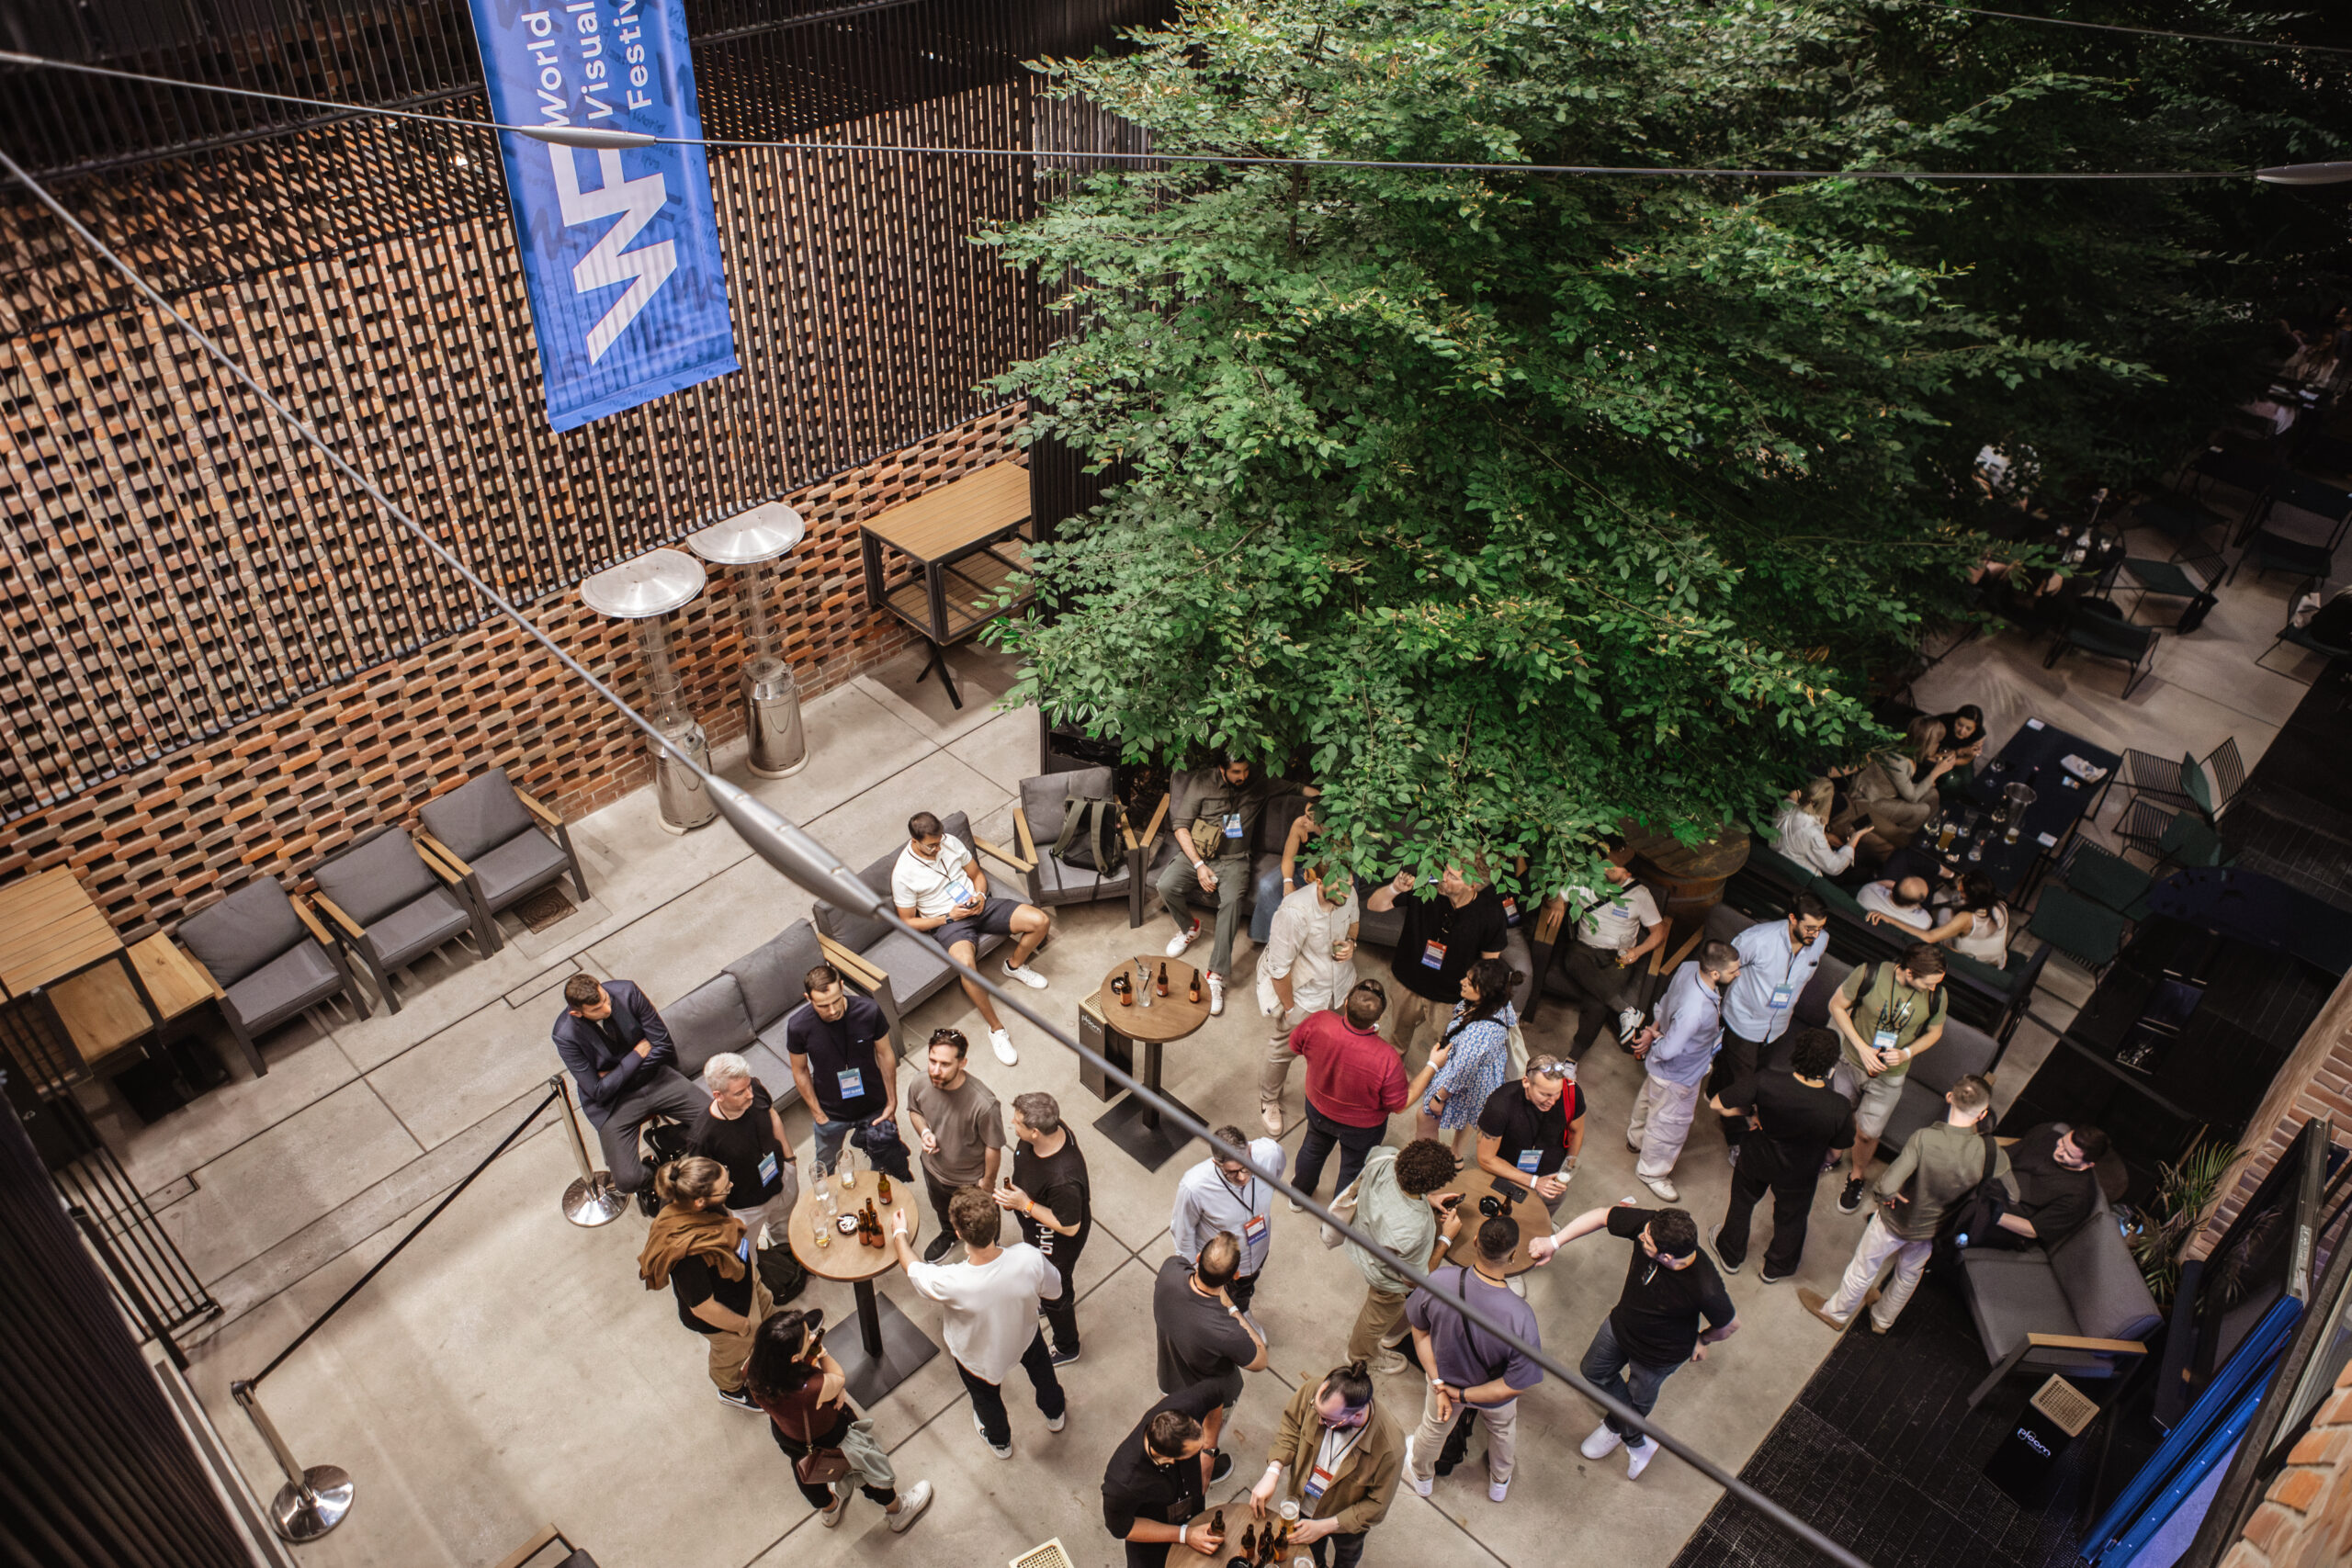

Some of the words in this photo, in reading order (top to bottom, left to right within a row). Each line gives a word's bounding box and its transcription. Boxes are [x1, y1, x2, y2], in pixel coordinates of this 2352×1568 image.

[520, 10, 570, 127] World
[565, 1, 614, 120] Visual
[1035, 1223, 1055, 1256] bric
